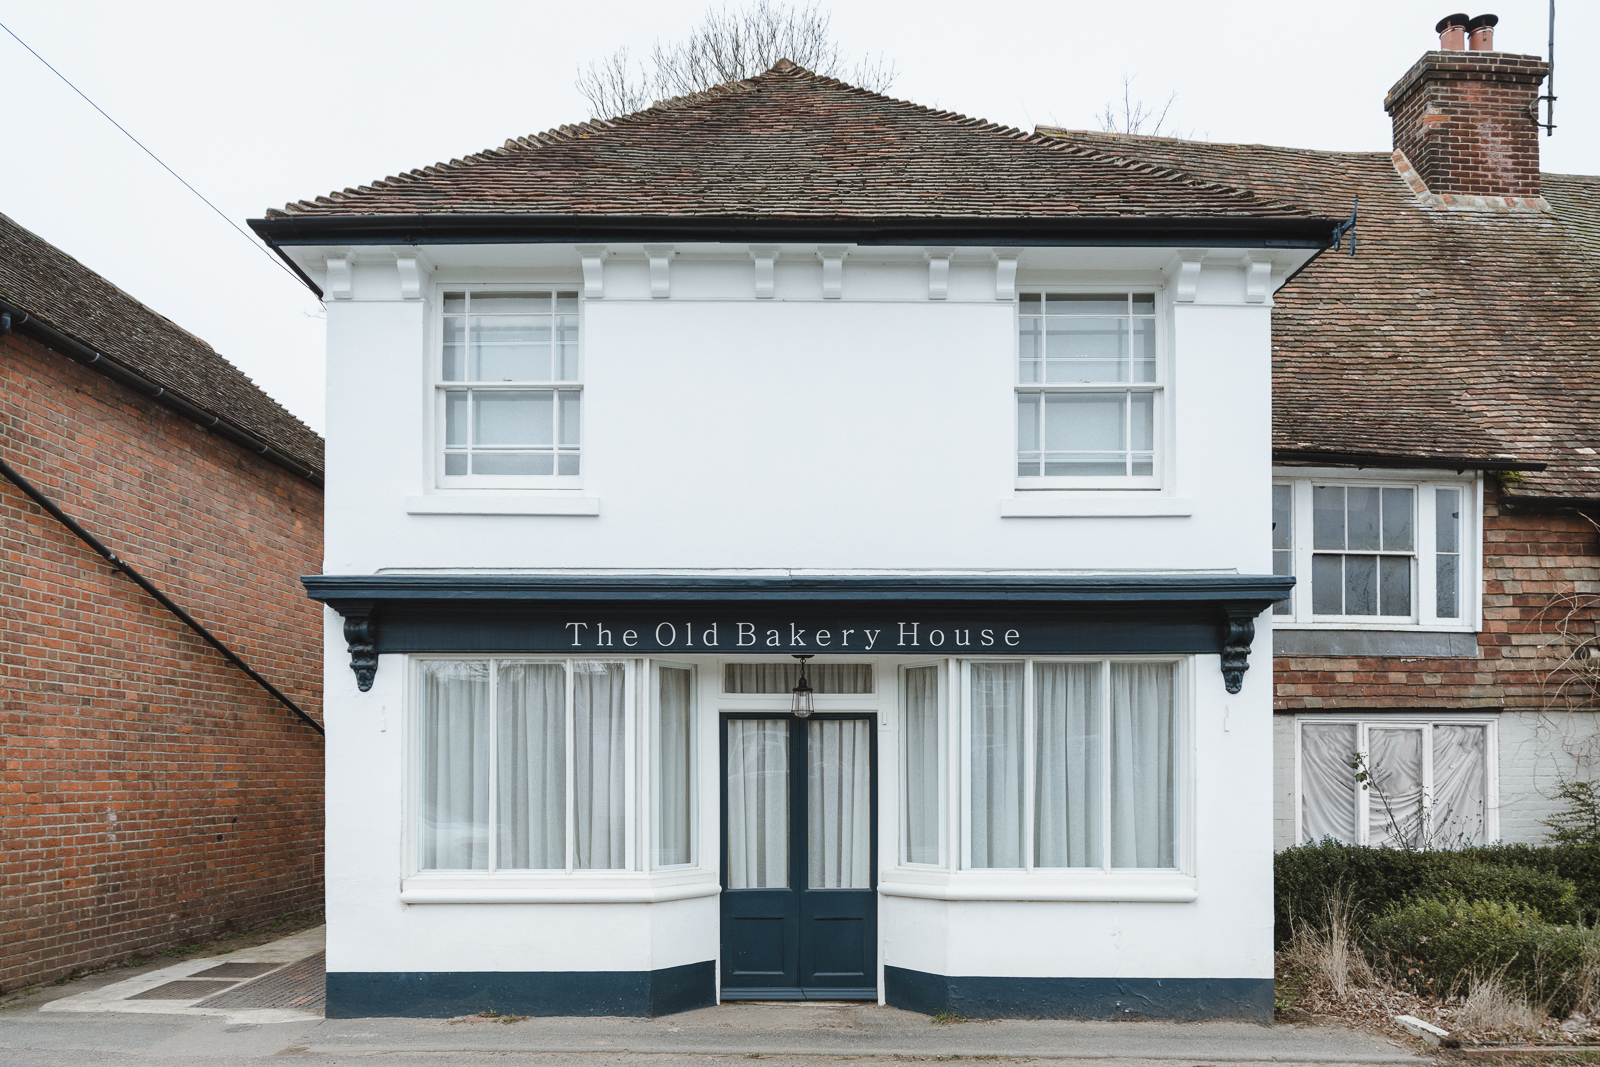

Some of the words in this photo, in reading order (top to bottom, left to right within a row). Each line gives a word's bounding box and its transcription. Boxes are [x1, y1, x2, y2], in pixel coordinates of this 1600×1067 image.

[565, 622, 638, 646] The
[655, 622, 719, 646] Old
[735, 622, 881, 651] Bakery
[896, 622, 1020, 646] House
